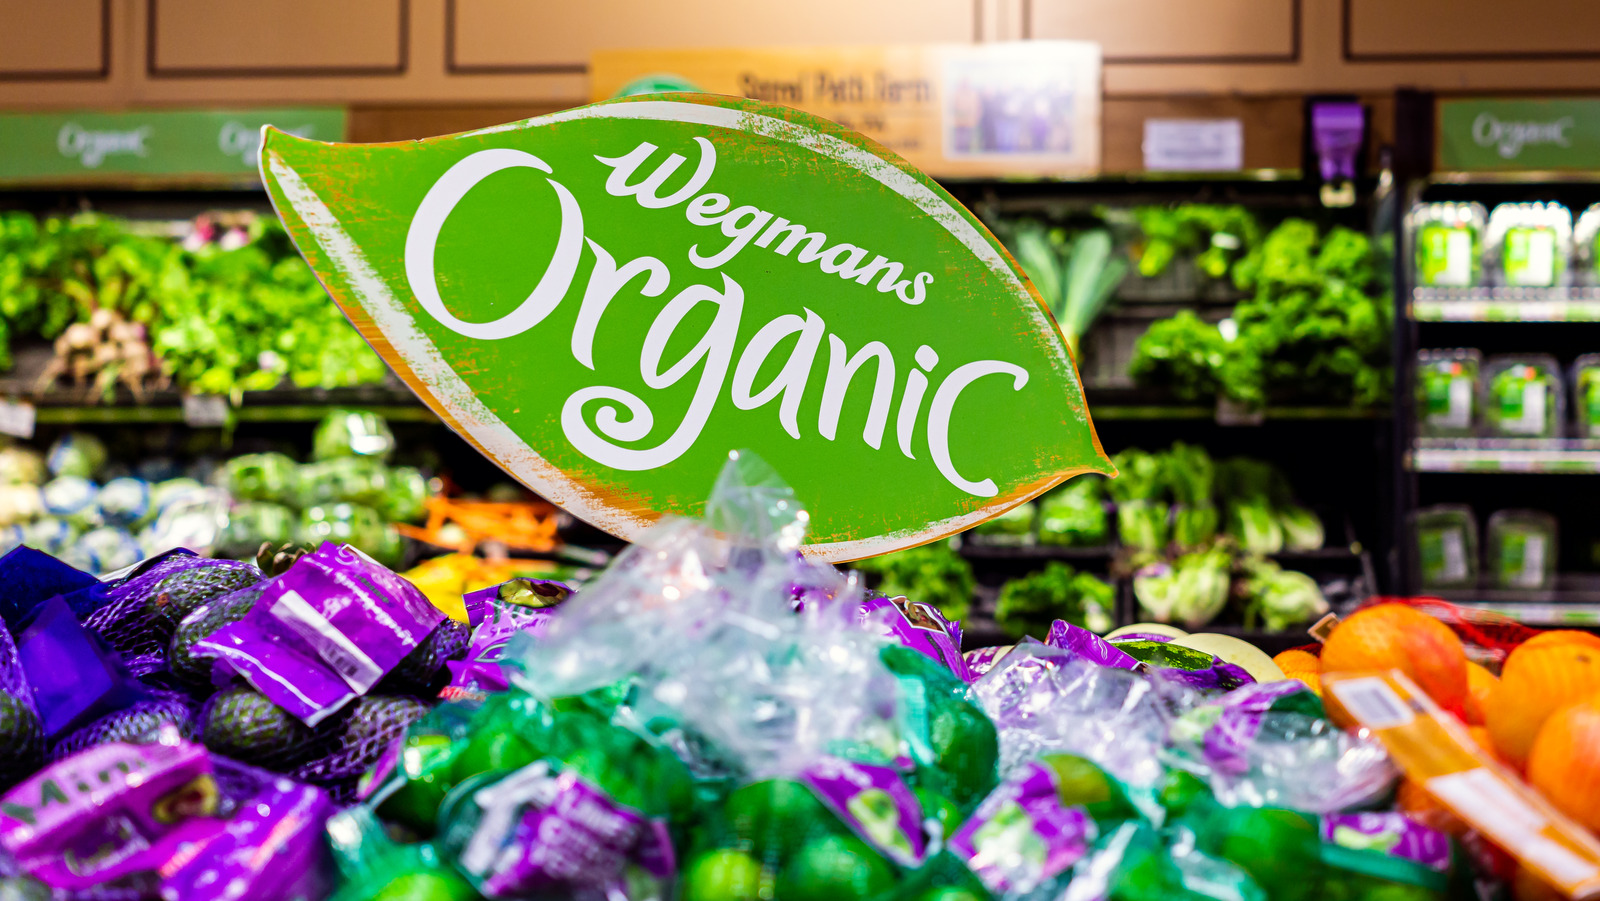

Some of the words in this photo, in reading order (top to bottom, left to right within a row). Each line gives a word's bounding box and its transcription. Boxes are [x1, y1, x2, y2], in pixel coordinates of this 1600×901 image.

[1472, 112, 1573, 159] Organic
[594, 136, 934, 305] Wegmans
[405, 148, 1029, 498] Organic
